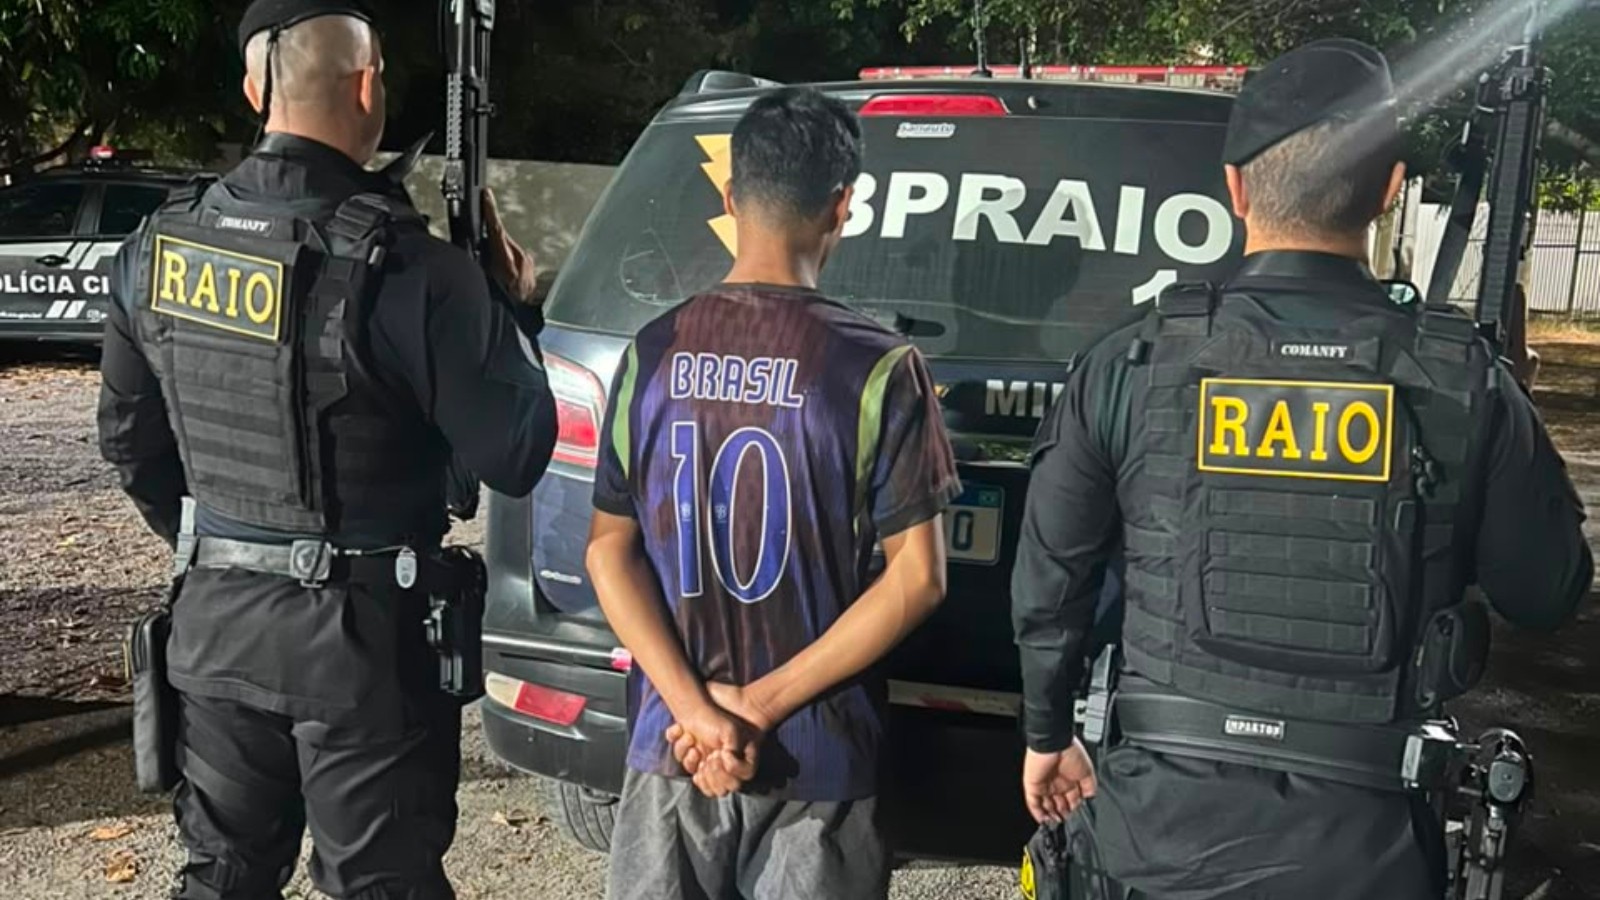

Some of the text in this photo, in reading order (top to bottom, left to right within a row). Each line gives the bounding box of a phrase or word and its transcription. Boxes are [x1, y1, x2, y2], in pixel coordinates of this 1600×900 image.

[0, 270, 109, 294] LÍCIA CI
[160, 250, 274, 324] RAIO
[671, 352, 803, 408] BRASIL
[1279, 343, 1348, 358] COMANFY
[1210, 396, 1380, 464] RAIO
[671, 421, 792, 604] 10
